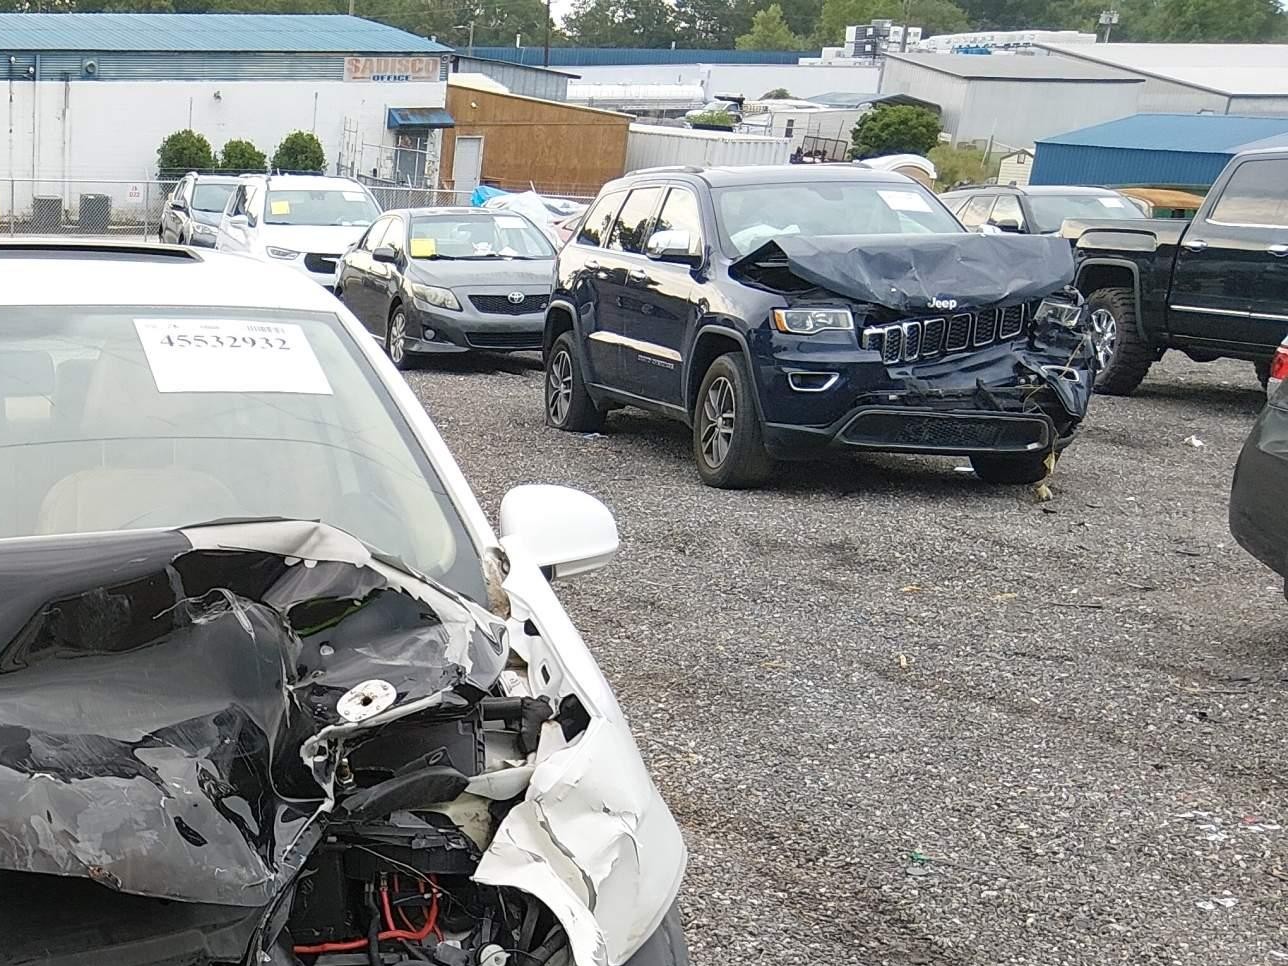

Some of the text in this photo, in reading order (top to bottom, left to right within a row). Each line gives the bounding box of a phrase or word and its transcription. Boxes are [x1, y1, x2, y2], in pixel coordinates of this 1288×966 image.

[347, 58, 438, 73] SADISCO
[926, 296, 958, 311] Jeep
[159, 334, 291, 351] 45532932
